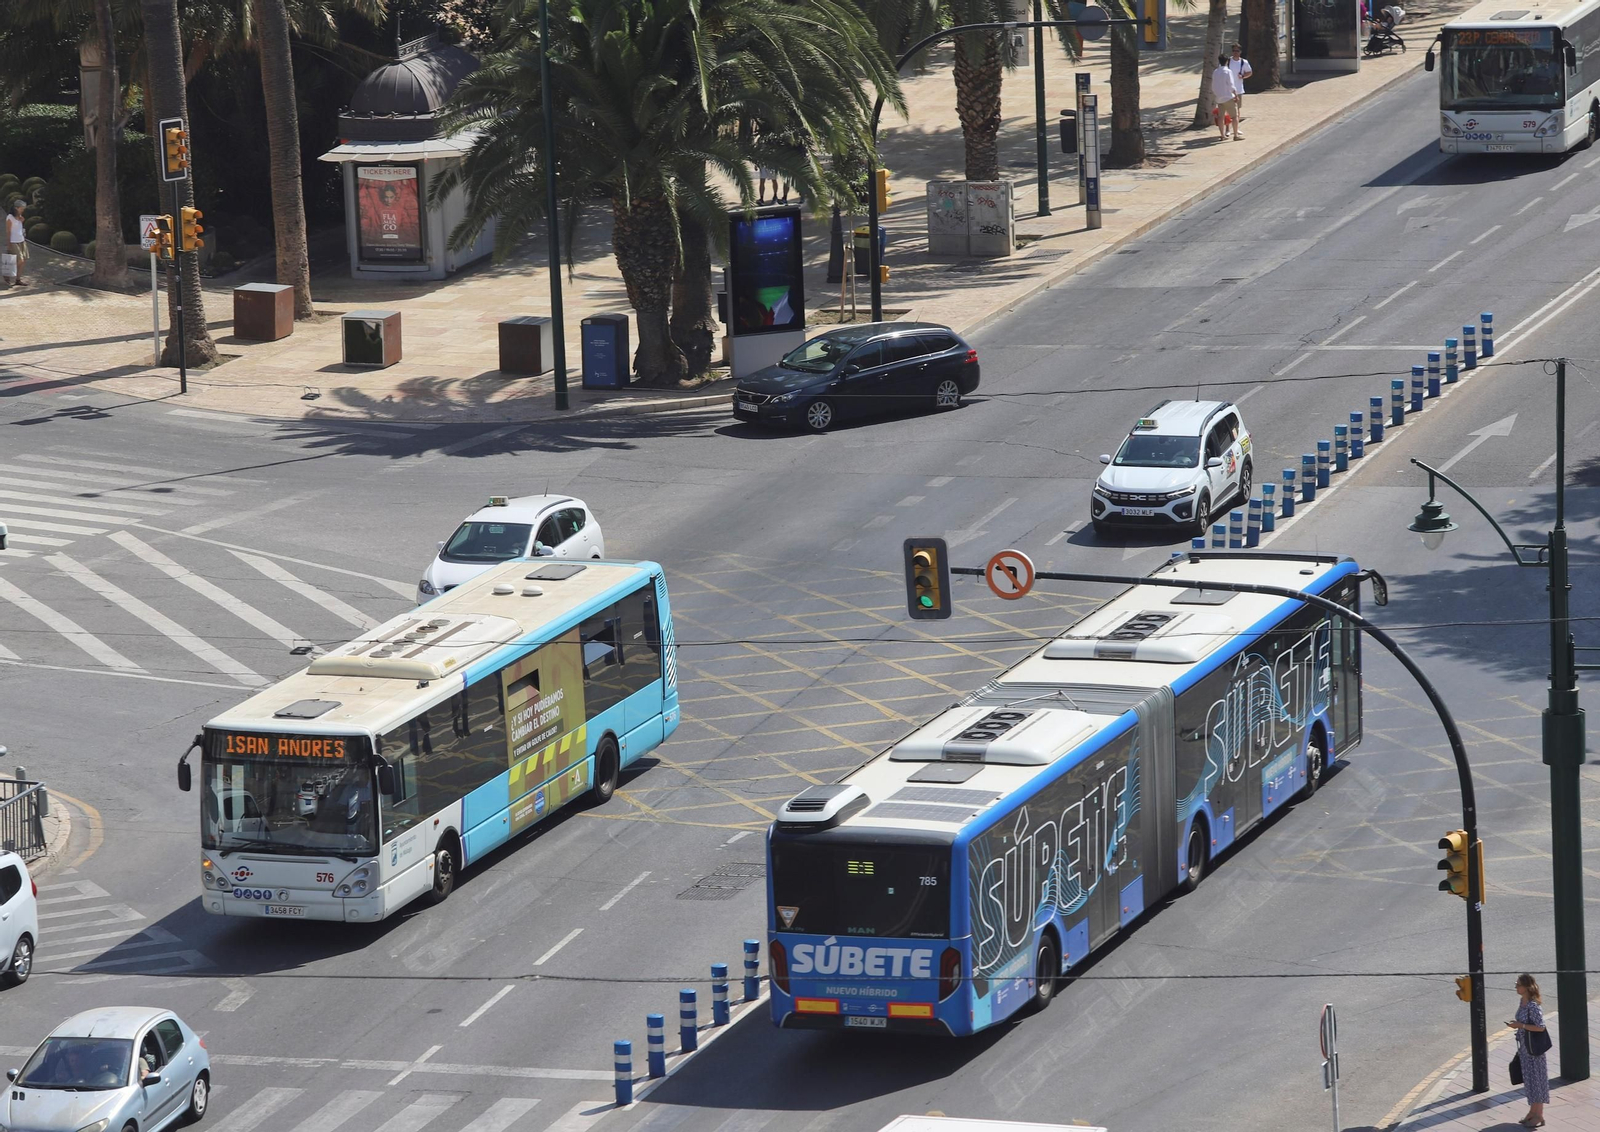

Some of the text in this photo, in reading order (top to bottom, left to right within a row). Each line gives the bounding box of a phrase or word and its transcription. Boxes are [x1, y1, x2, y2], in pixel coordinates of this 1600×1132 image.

[1522, 120, 1536, 128] 579
[517, 711, 523, 724] SI
[523, 705, 534, 721] HOY
[533, 688, 564, 714] PUDIÉRAMOS
[511, 721, 533, 742] CAMBIAR
[533, 717, 540, 730] EL
[539, 705, 560, 726] DESTINO
[226, 735, 345, 758] 1SAN ANDRES
[316, 872, 334, 883] 576
[919, 876, 937, 886] 785
[270, 906, 302, 915] 3458 FCY
[791, 935, 933, 978] SÚBETE
[825, 985, 898, 997] NUEVO HÍBRIDO
[850, 1017, 867, 1026] 1540
